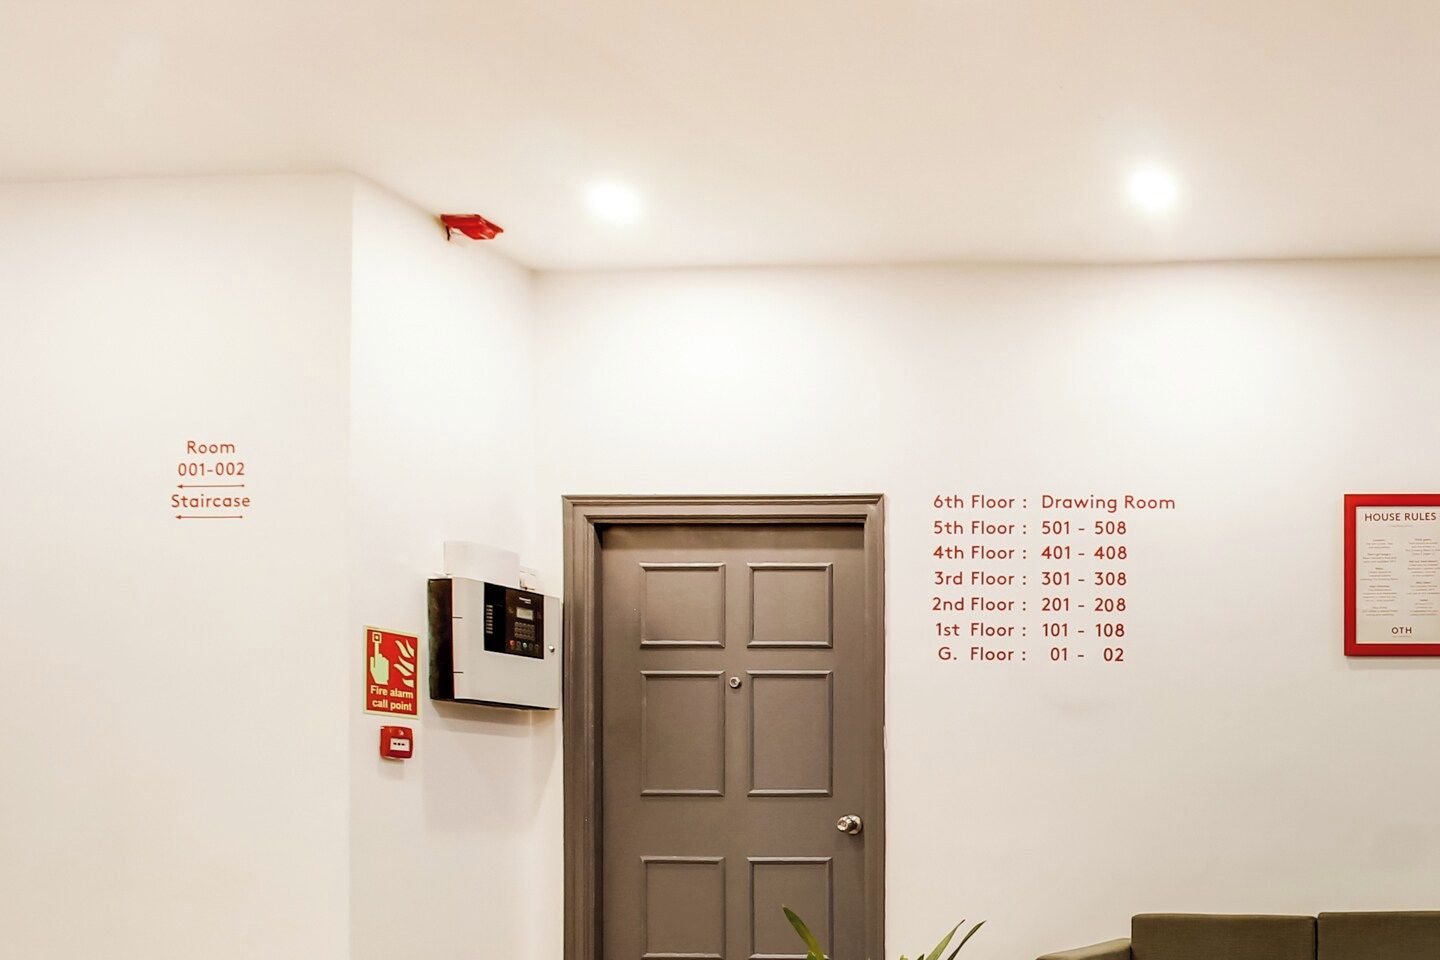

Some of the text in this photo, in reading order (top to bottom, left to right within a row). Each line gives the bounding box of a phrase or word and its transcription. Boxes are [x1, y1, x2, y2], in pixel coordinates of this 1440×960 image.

[187, 440, 236, 454] Room
[177, 462, 245, 477] 001-002
[171, 493, 251, 508] Staircase
[933, 494, 964, 509] 6th
[971, 494, 1016, 509] Floor
[1042, 494, 1117, 514] Drawing
[1124, 494, 1176, 510] Room
[1364, 512, 1437, 522] HOUSE RULES
[933, 520, 964, 535] 5th
[971, 520, 1015, 535] Floor
[1041, 520, 1070, 535] 501
[1094, 520, 1127, 535] 508
[932, 545, 964, 560] 4th
[971, 545, 1015, 560] Floor
[1040, 545, 1070, 560] 401
[1093, 545, 1128, 560] 408
[934, 571, 963, 586] 3rd
[971, 571, 1015, 586] Floor
[1041, 571, 1070, 586] 301
[1094, 571, 1127, 586] 308
[932, 596, 965, 611] 2nd
[971, 596, 1015, 612] Floor
[1041, 597, 1069, 612] 201
[1094, 597, 1127, 613] 208
[935, 622, 960, 637] 1st
[970, 622, 1015, 637] Floor
[1042, 622, 1068, 637] 101
[1095, 623, 1125, 638] 108
[1391, 626, 1413, 635] OTH
[938, 646, 957, 661] G.
[970, 646, 1015, 661] Floor
[1050, 647, 1068, 662] 01
[1103, 647, 1124, 662] 02
[370, 685, 414, 699] Fire alarm
[371, 699, 412, 712] call point
